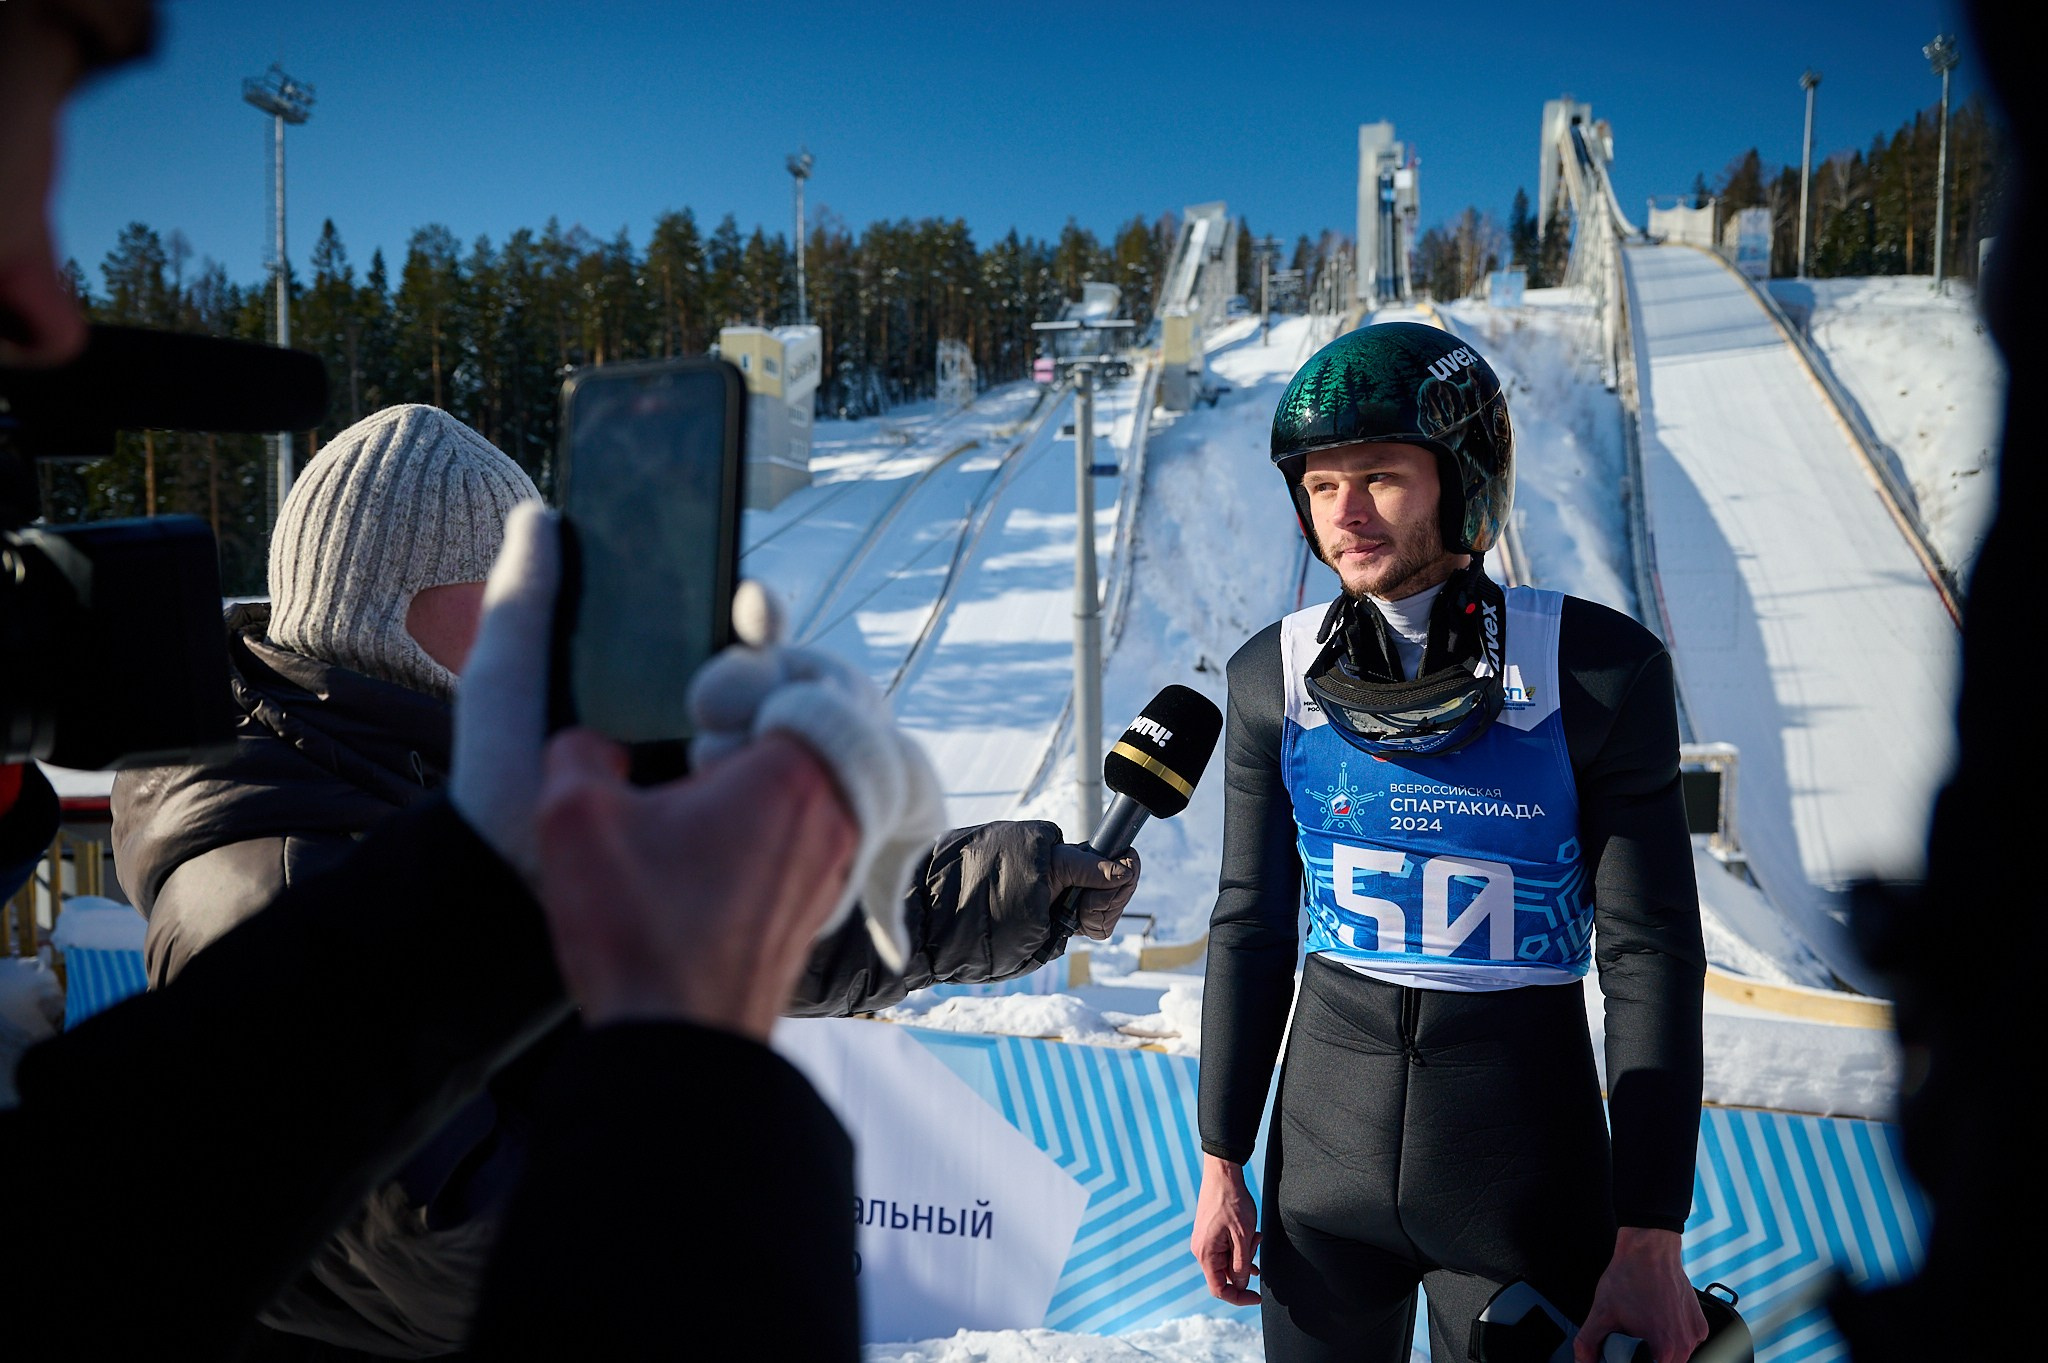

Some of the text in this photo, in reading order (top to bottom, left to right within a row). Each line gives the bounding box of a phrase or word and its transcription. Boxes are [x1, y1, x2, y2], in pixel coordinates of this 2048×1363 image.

[1427, 346, 1478, 381] uvex
[1481, 599, 1500, 673] uvex
[1126, 715, 1174, 748] АТЧ!
[1389, 783, 1502, 798] ВСЕРОССИЙСКАЯ
[1389, 797, 1546, 820] СПАРТАКИАДА
[1389, 816, 1443, 832] 2024
[1332, 842, 1516, 961] 50
[853, 1195, 994, 1240] альный
